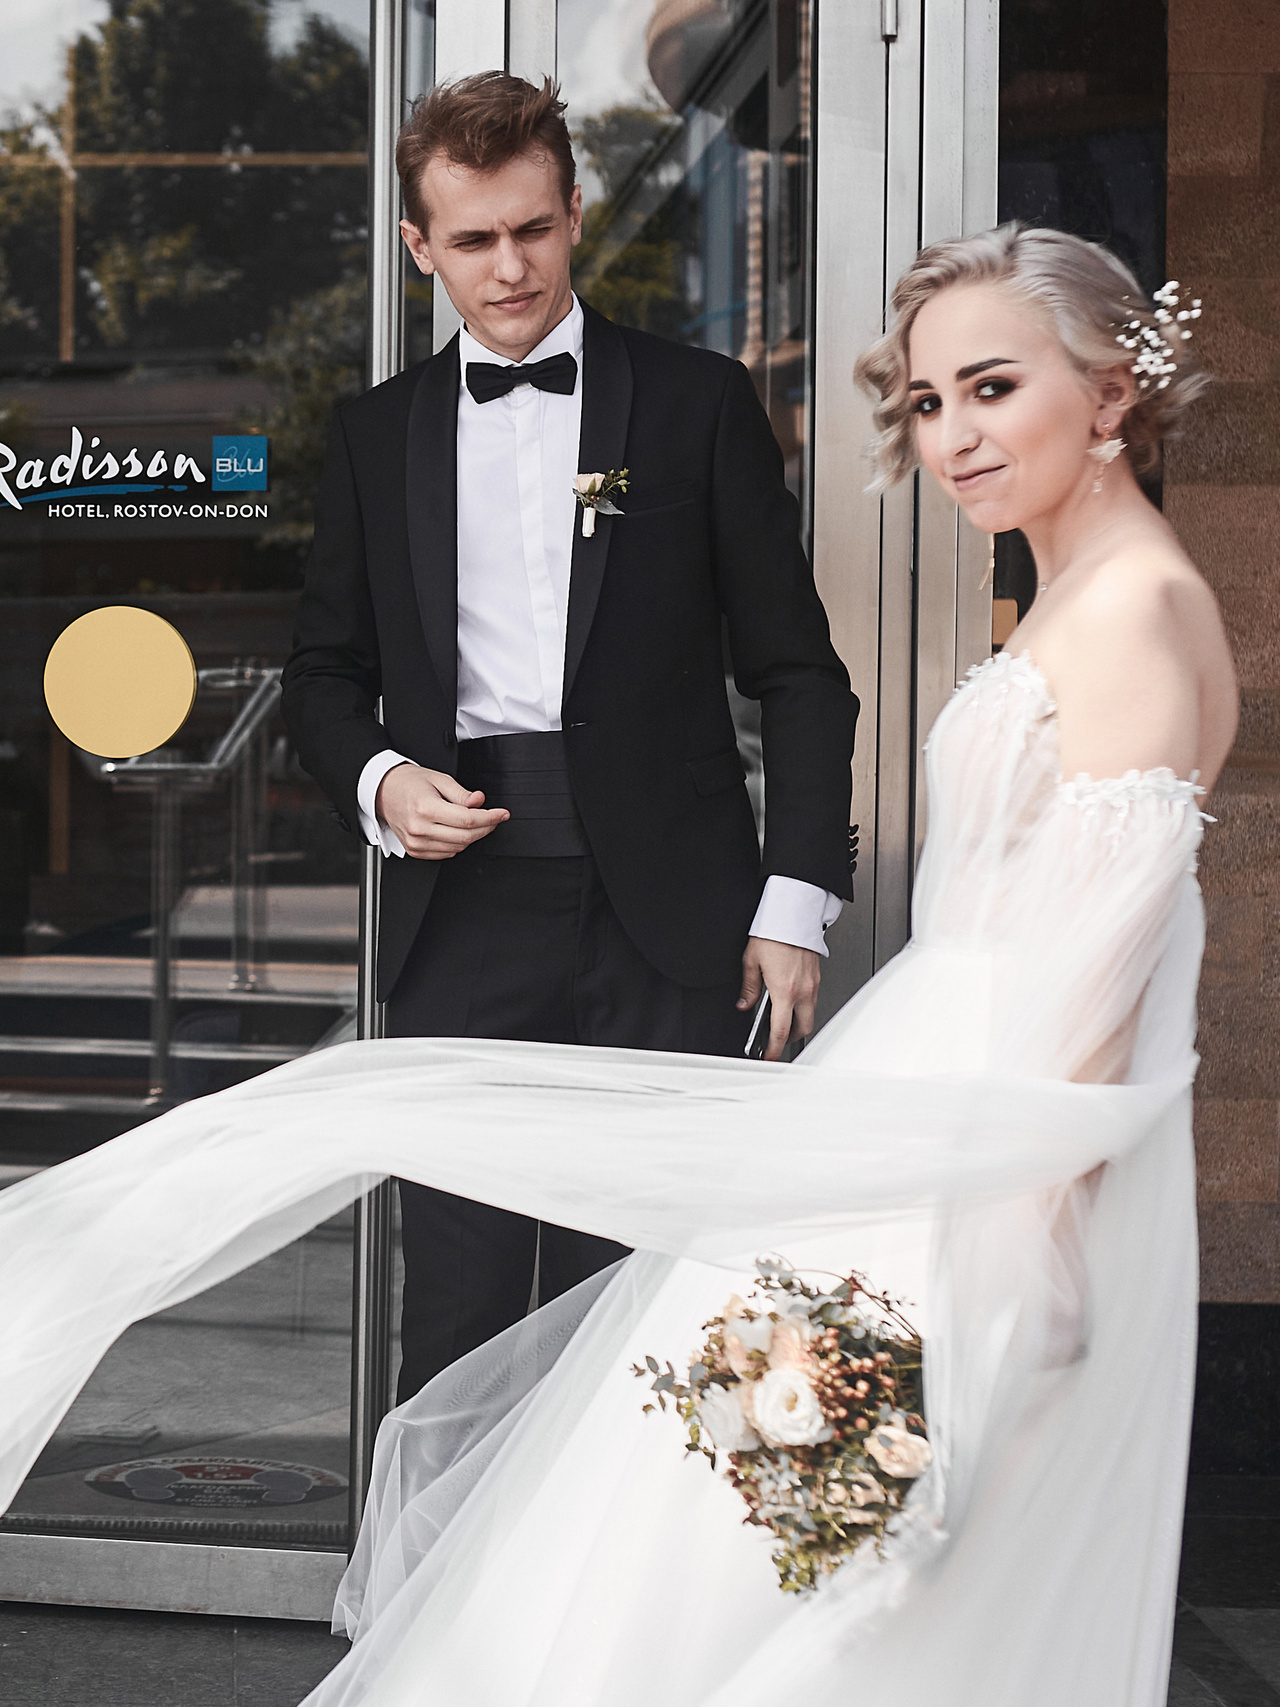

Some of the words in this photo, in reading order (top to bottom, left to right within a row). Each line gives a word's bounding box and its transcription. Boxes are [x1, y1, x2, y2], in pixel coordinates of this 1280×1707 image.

[215, 457, 264, 473] BLU
[48, 504, 110, 519] HOTEL,
[114, 504, 268, 518] ROSTOV-ON-DON
